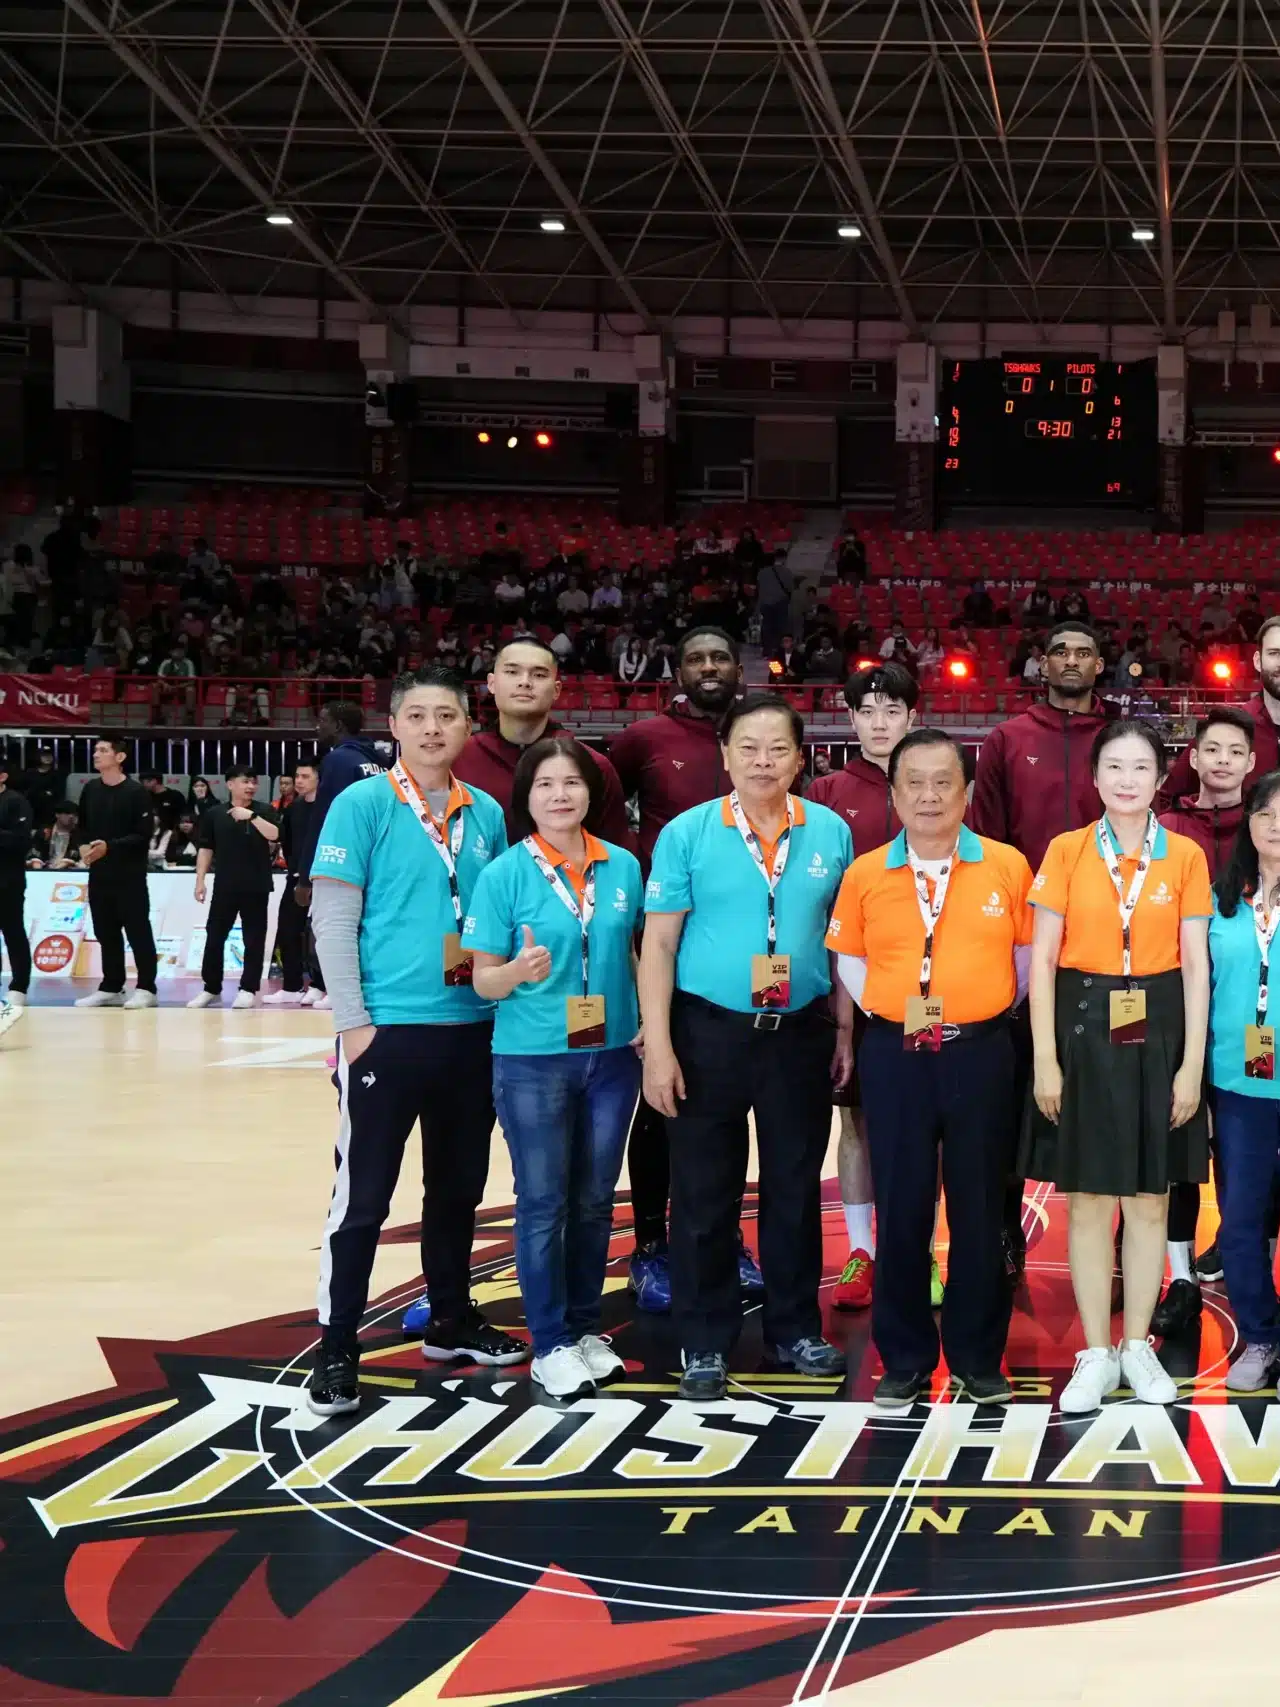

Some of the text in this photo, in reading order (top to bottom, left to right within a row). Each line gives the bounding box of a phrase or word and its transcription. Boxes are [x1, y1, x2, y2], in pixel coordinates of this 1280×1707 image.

[1067, 364, 1096, 374] PILOTS
[1022, 377, 1032, 393] 0
[1081, 378, 1092, 393] 0
[1005, 400, 1014, 413] 0
[1085, 401, 1094, 414] 0
[1111, 417, 1121, 427] 13
[1038, 421, 1071, 437] 9:30
[1107, 429, 1121, 440] 21
[945, 458, 959, 469] 23
[17, 690, 79, 707] NCKU
[320, 845, 347, 859] TSG
[660, 1506, 1147, 1539] TAINAN
